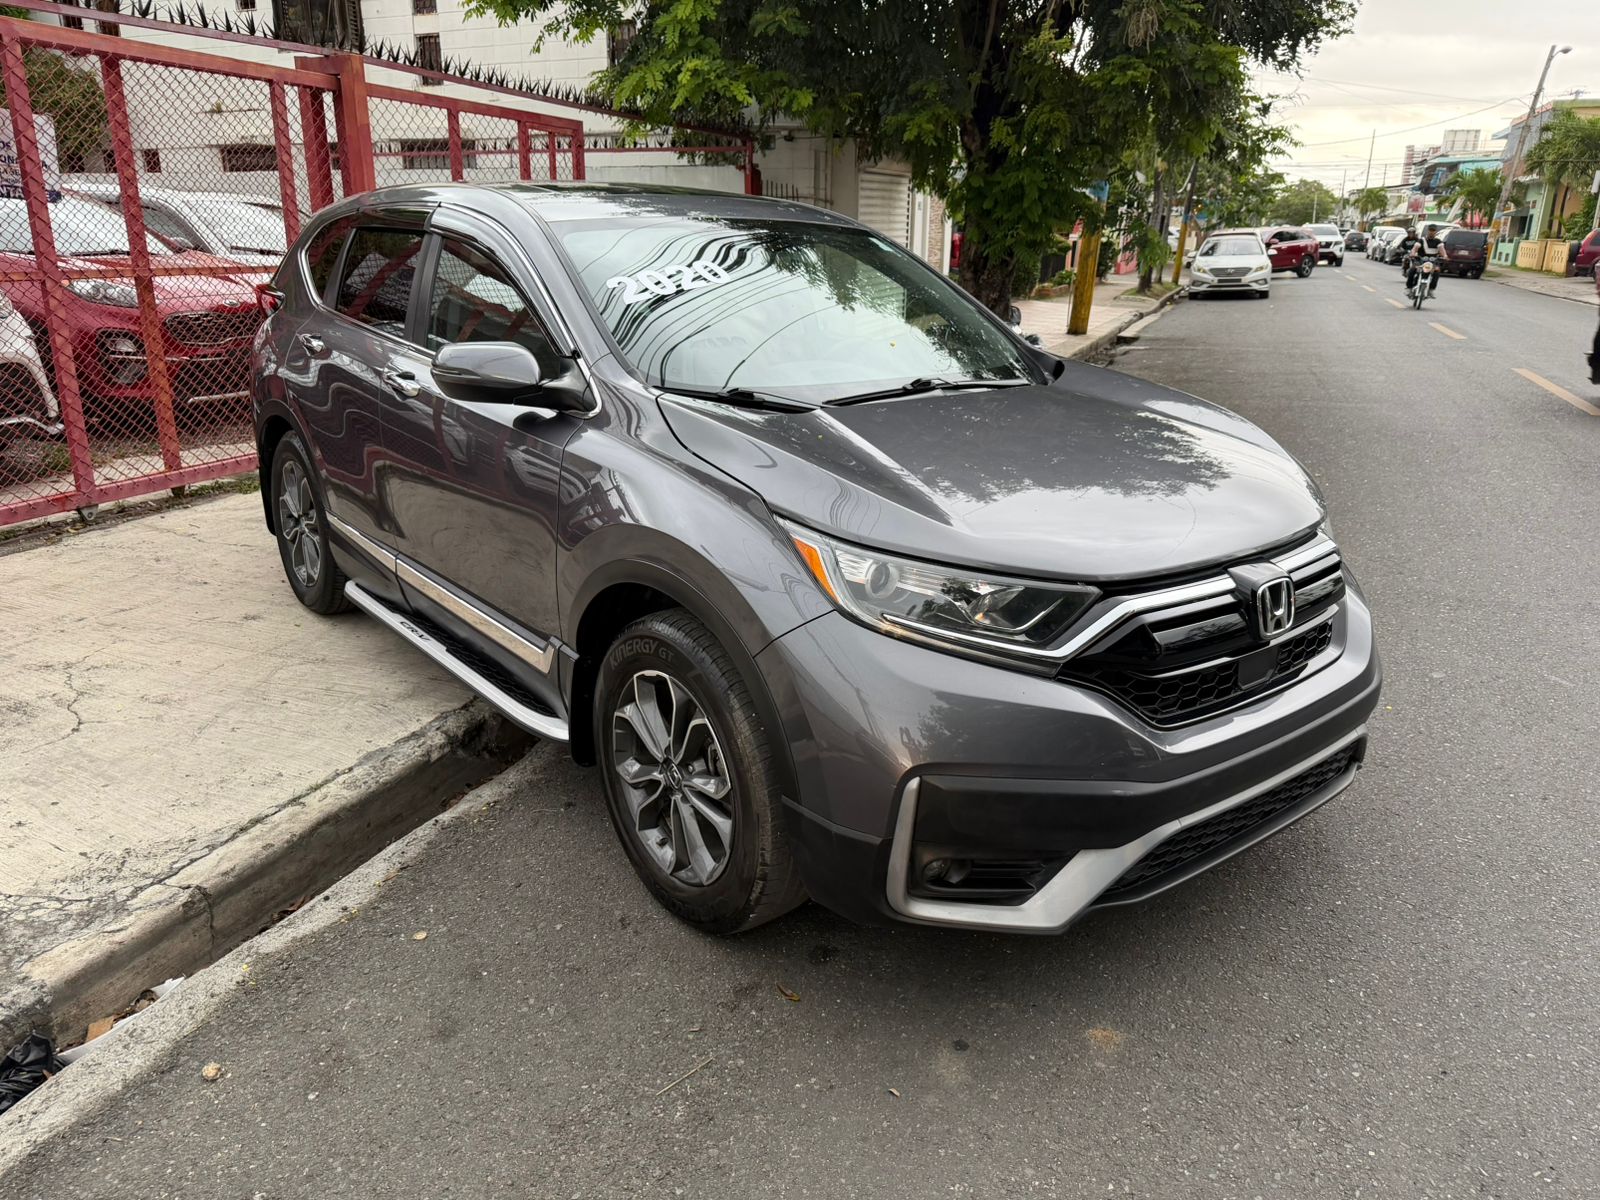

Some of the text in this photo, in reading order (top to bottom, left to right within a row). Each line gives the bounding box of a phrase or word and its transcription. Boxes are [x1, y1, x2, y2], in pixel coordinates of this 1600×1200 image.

[606, 260, 731, 304] 2020
[609, 639, 675, 670] KINERGY GT
